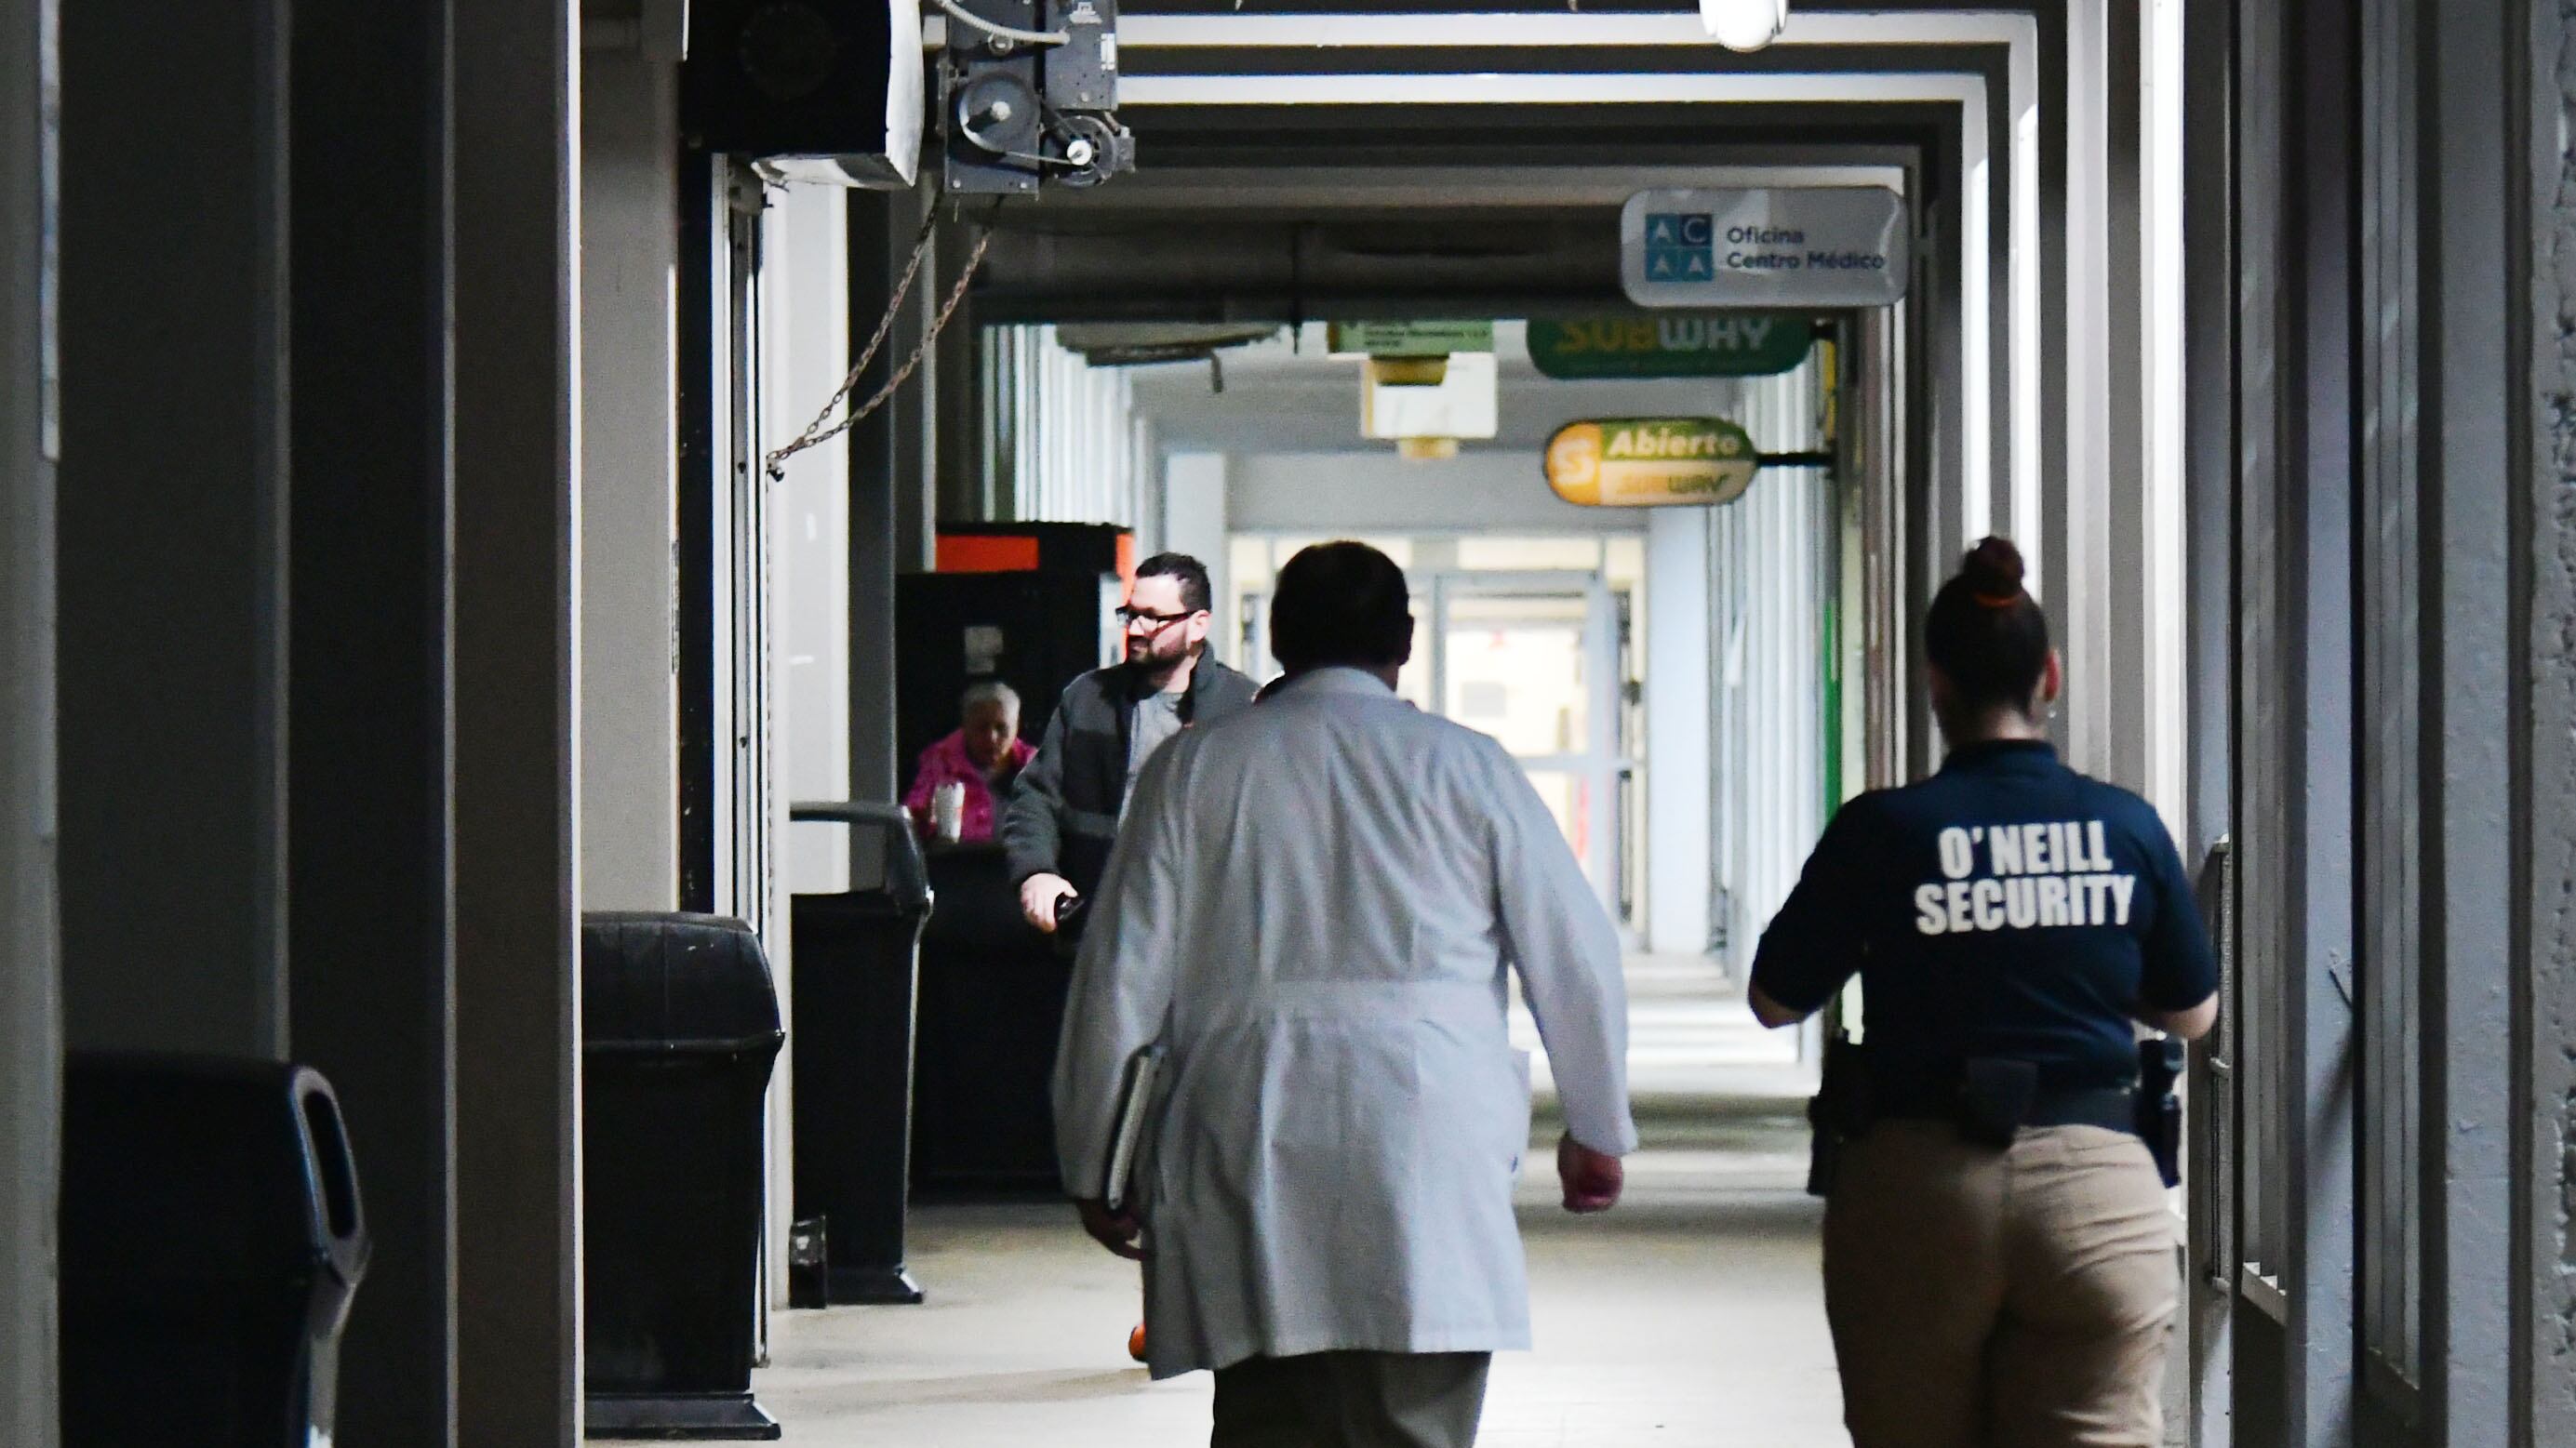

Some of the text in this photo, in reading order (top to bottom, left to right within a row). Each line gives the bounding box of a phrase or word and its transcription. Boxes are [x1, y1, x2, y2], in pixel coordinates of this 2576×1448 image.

[1726, 224, 1805, 246] Oficina
[1726, 249, 1886, 270] Centro Médico
[1553, 316, 1772, 352] SUBWAY
[1608, 427, 1741, 457] Abierto
[1938, 820, 2114, 880] O'NEILL
[1915, 874, 2136, 936] SECURITY
